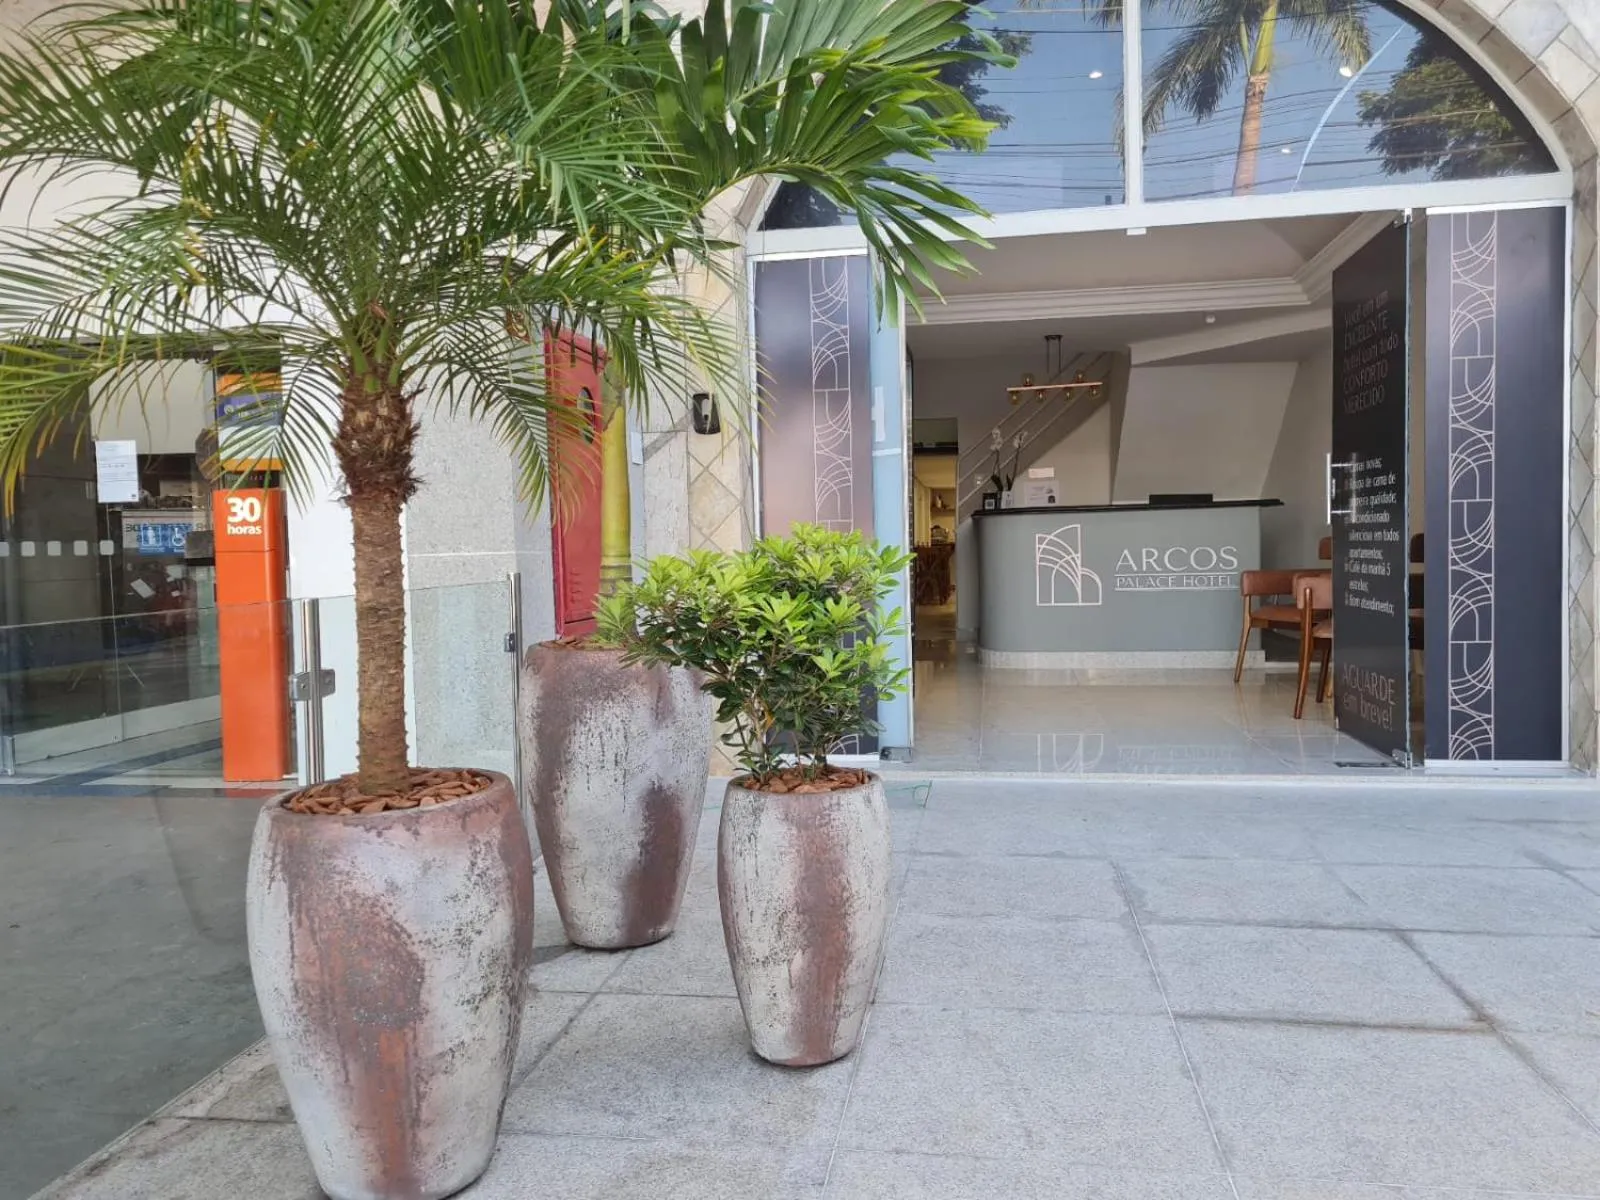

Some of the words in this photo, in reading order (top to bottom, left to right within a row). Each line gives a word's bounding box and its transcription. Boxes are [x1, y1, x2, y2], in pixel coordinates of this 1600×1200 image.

[1343, 359, 1388, 395] CONFORTO
[1343, 384, 1385, 414] MERECIDO
[227, 497, 261, 523] 30
[227, 523, 262, 535] horas
[1115, 546, 1238, 572] ARCOS
[1386, 562, 1391, 577] 5
[1117, 576, 1177, 588] PALACE
[1183, 575, 1233, 587] HOTEL
[1342, 662, 1396, 706] AGUARDE
[1360, 692, 1393, 733] breve!
